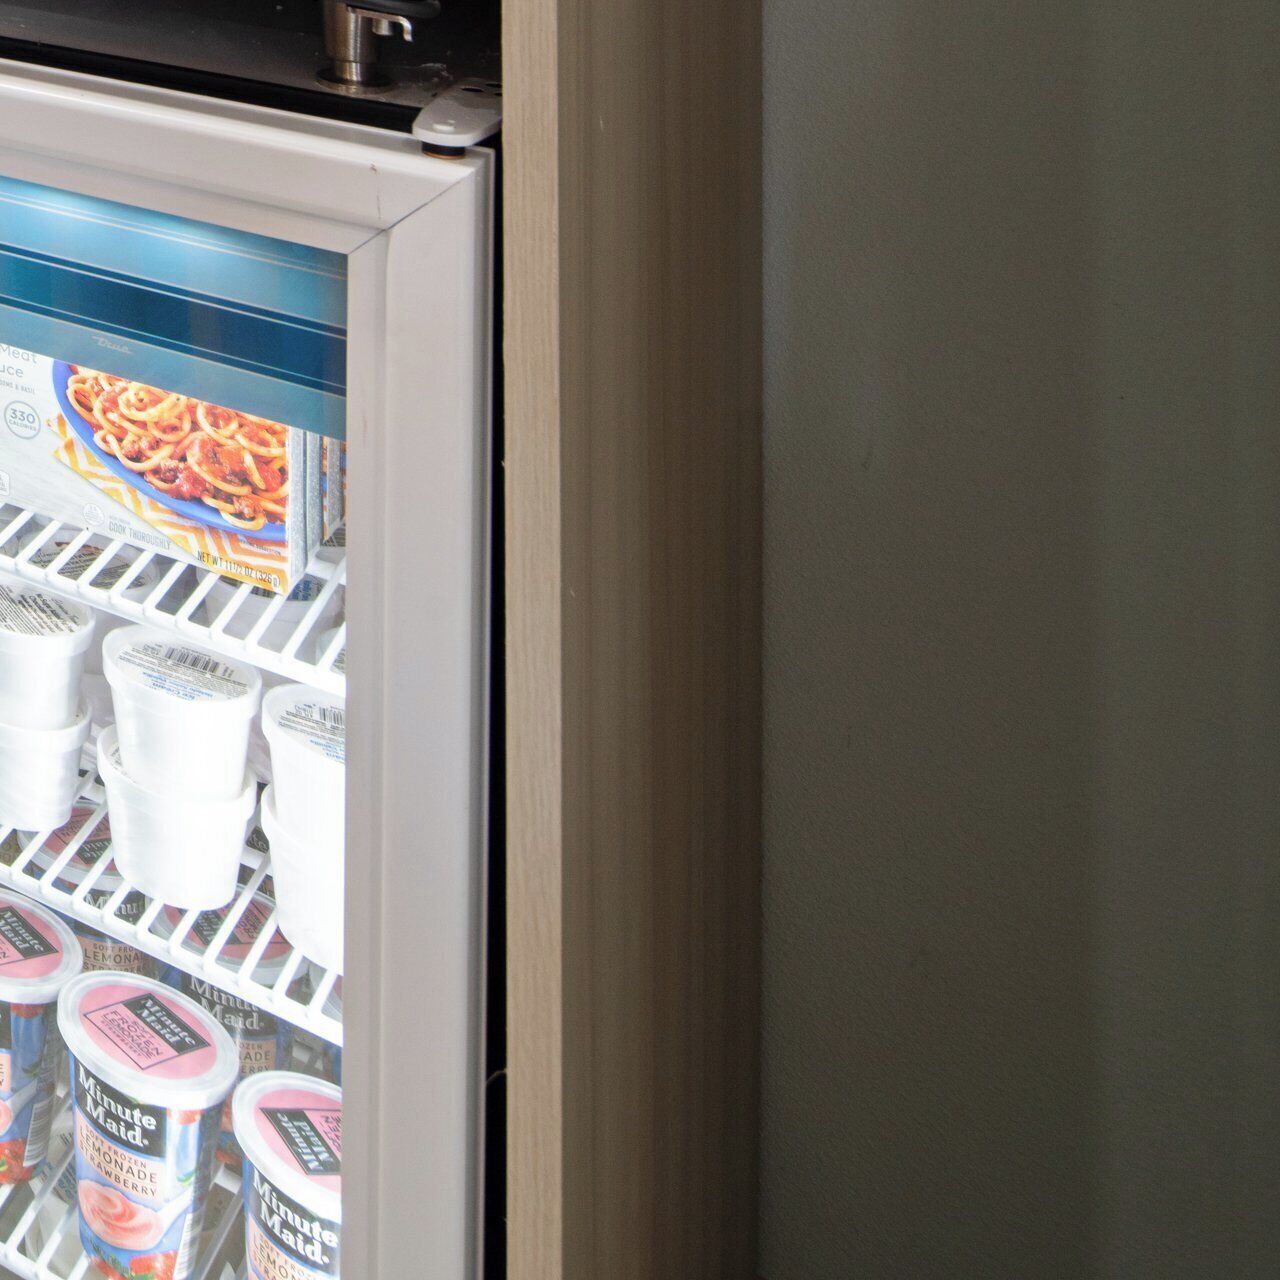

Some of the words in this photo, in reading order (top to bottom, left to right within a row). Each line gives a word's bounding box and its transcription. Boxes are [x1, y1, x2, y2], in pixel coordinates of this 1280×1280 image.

[8, 420, 36, 432] CALORIES
[10, 408, 36, 424] 330
[108, 522, 126, 536] COOK
[128, 528, 172, 550] THOROUGHLY
[197, 550, 210, 564] NET
[211, 554, 224, 566] WT
[244, 568, 255, 578] OZ
[0, 910, 44, 952] Minute
[138, 1009, 180, 1044] Maid
[140, 998, 196, 1046] Minute
[200, 998, 260, 1030] Maid
[78, 1063, 157, 1130] Minute
[86, 1092, 143, 1147] Maid
[253, 1166, 339, 1248] Minute
[260, 1198, 324, 1265] Maid
